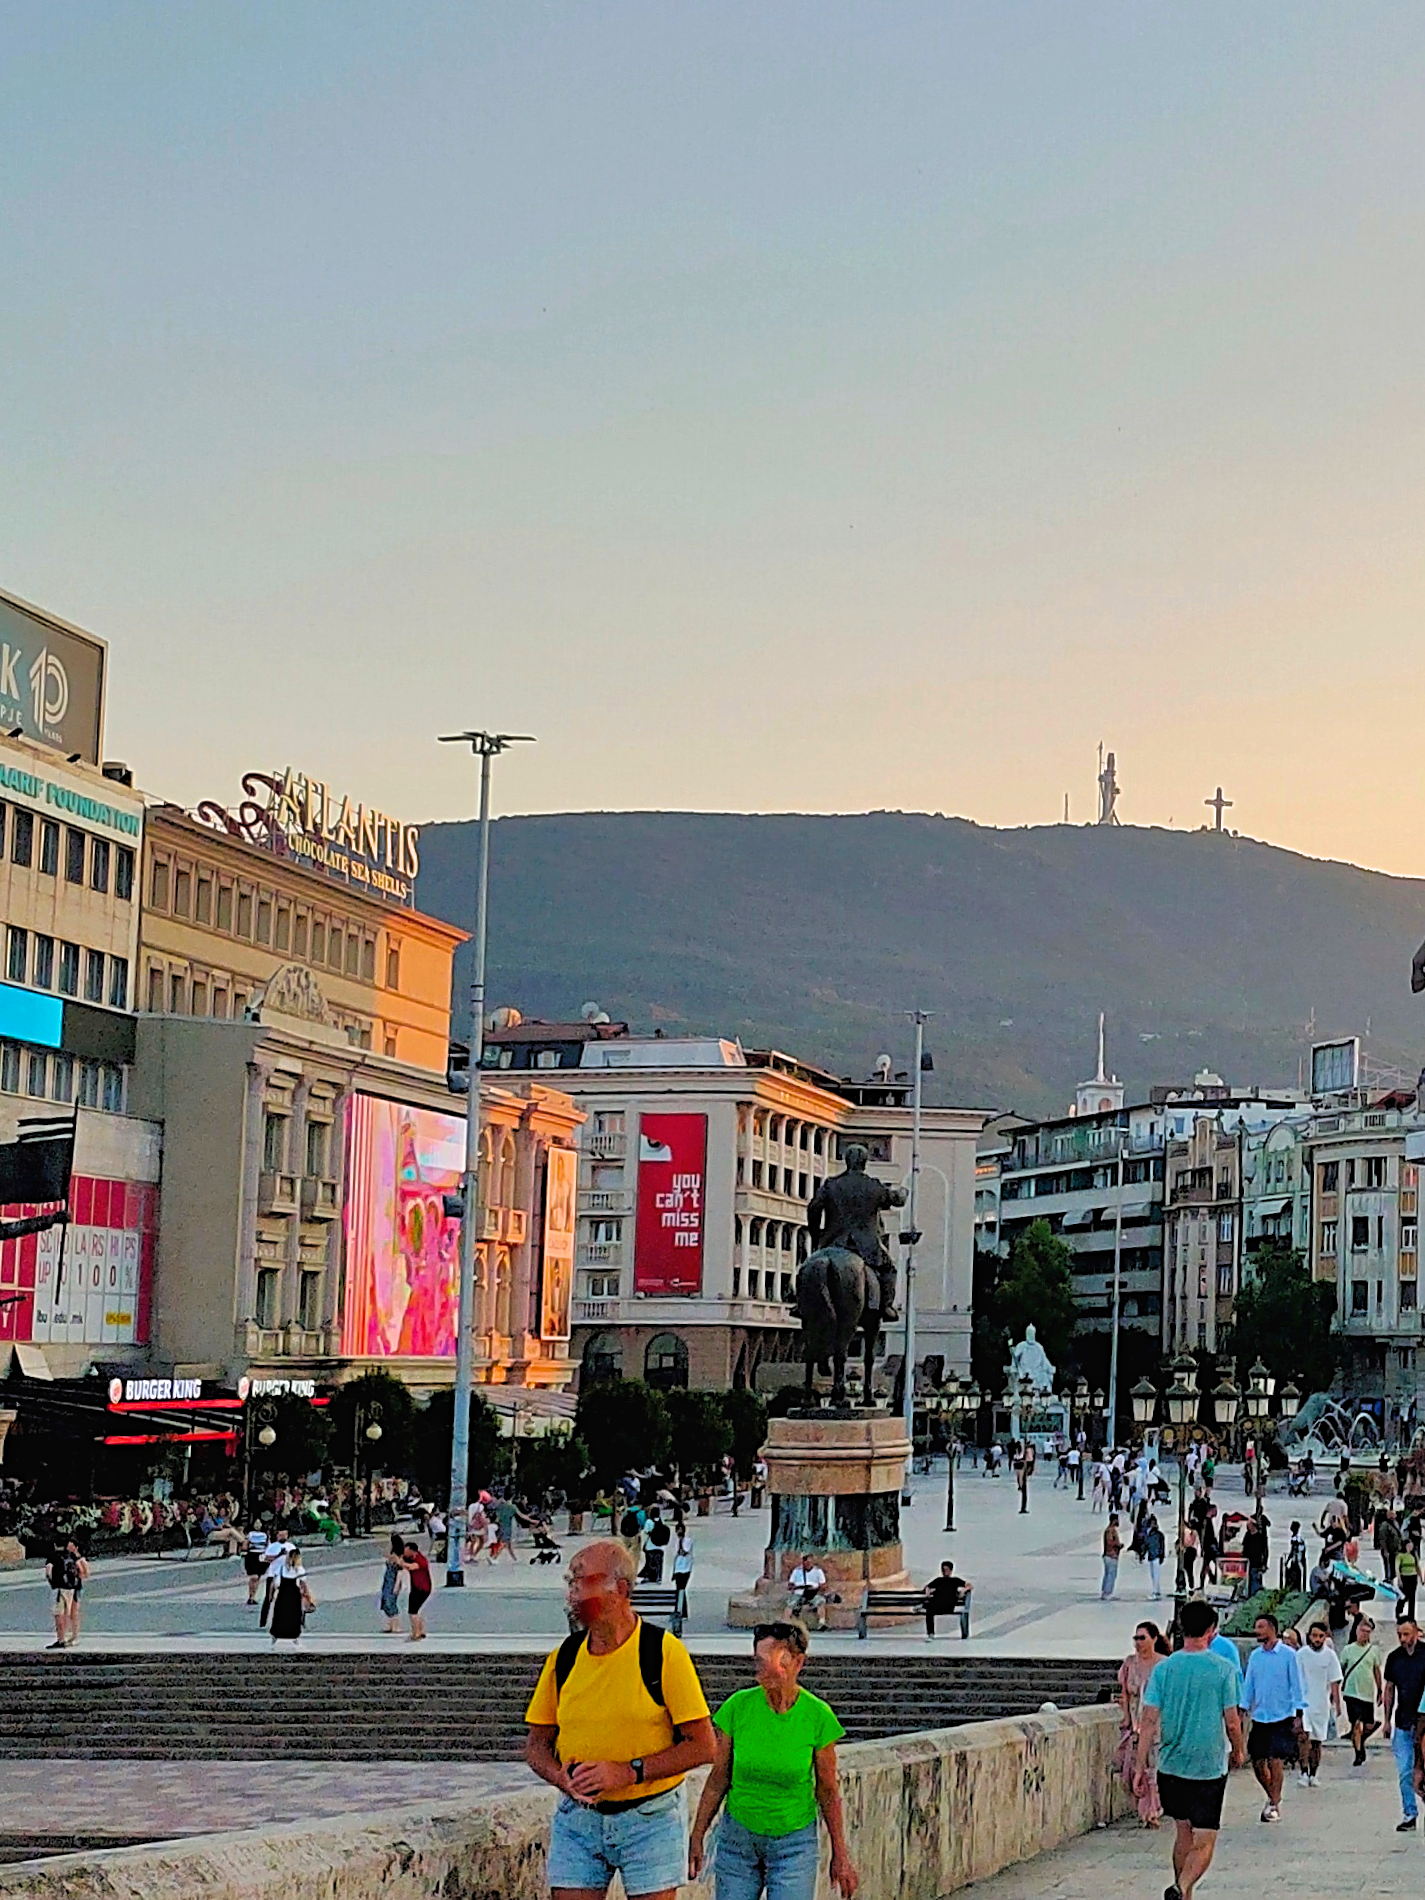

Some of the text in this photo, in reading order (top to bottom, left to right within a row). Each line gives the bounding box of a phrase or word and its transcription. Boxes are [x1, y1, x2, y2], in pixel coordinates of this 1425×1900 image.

[46, 782, 141, 838] FOUNDATION
[277, 765, 419, 880] ATLANTIS
[288, 834, 408, 900] CHOCOLATE SEA SHELLS
[672, 1173, 700, 1193] you
[661, 1208, 700, 1228] miss
[674, 1231, 700, 1247] me
[126, 1379, 202, 1400] BURGER KING
